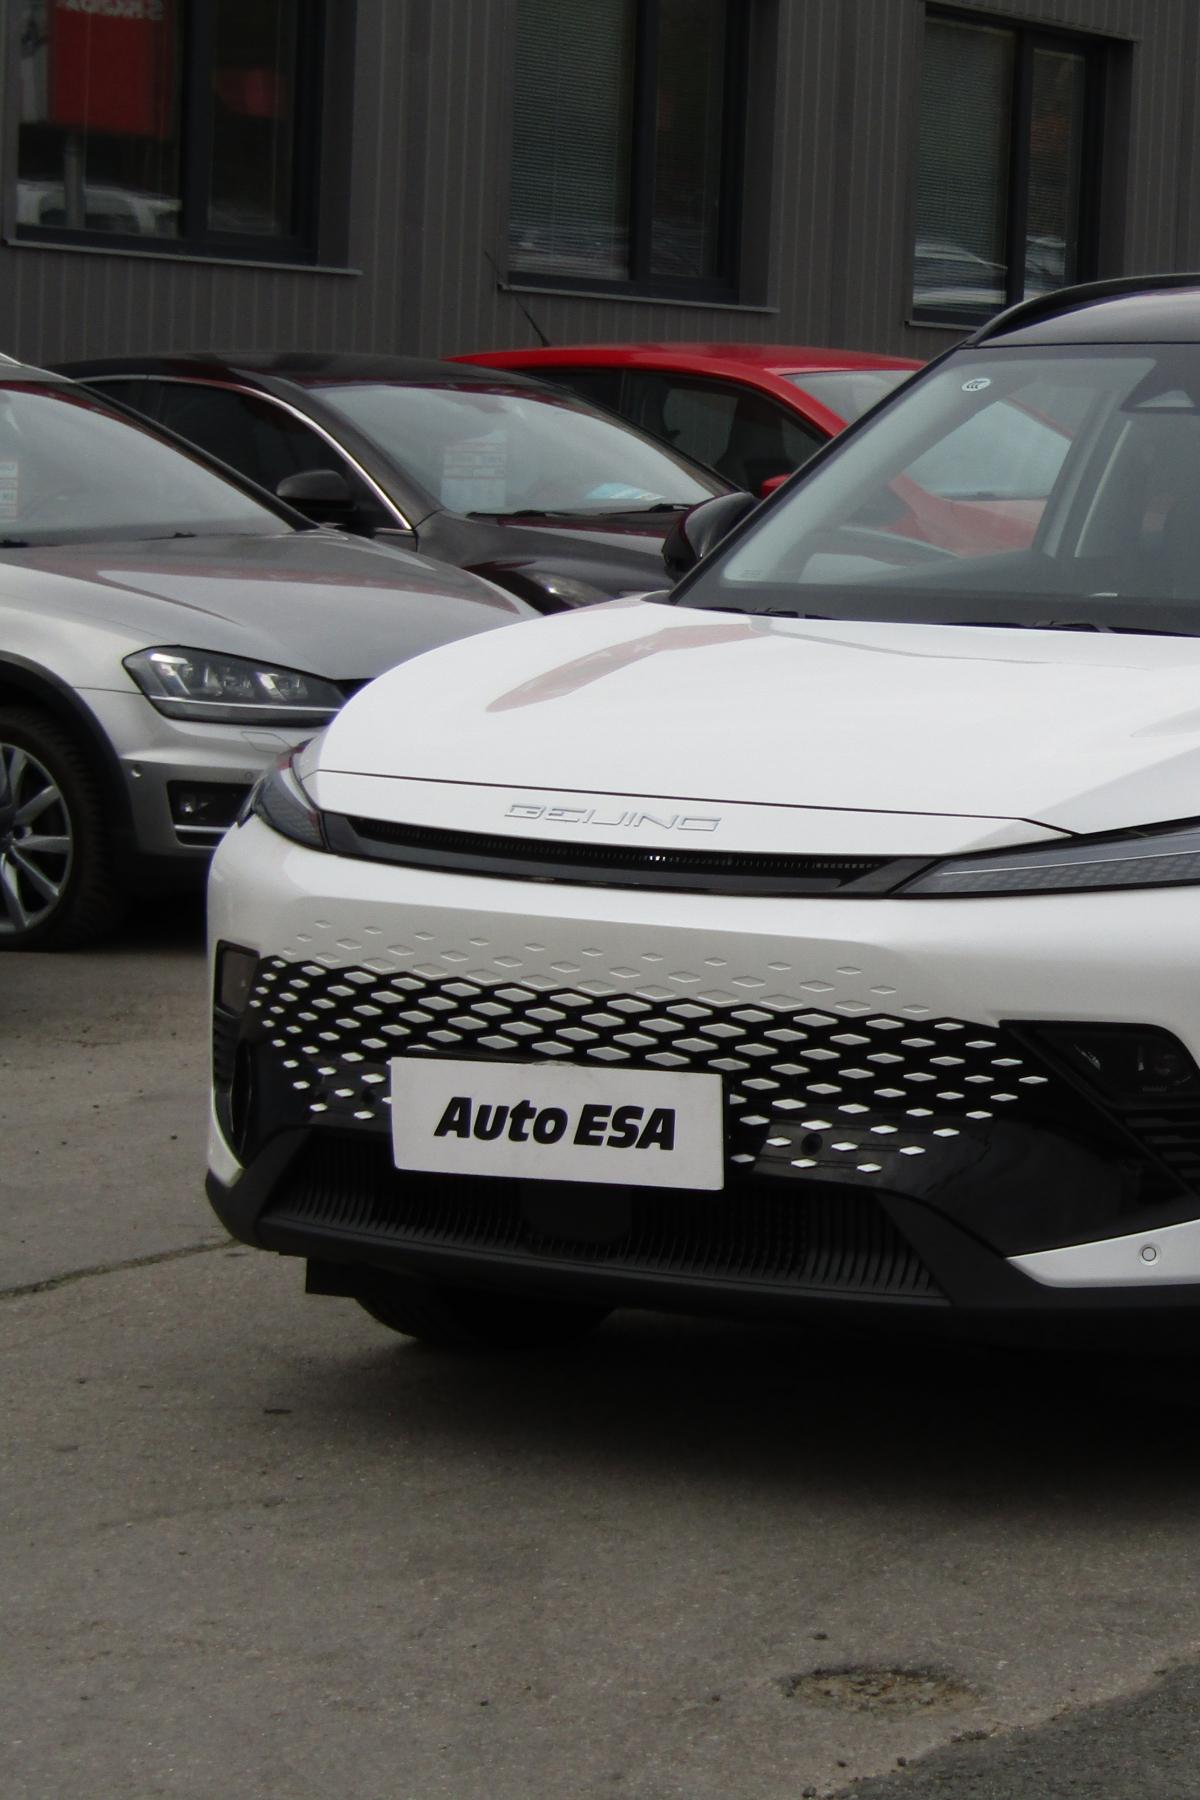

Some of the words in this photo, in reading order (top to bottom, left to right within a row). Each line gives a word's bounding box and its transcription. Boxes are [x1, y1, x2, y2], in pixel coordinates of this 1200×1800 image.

[504, 803, 722, 832] BEIJING
[433, 1096, 568, 1145] Auto
[573, 1103, 676, 1151] ESA
